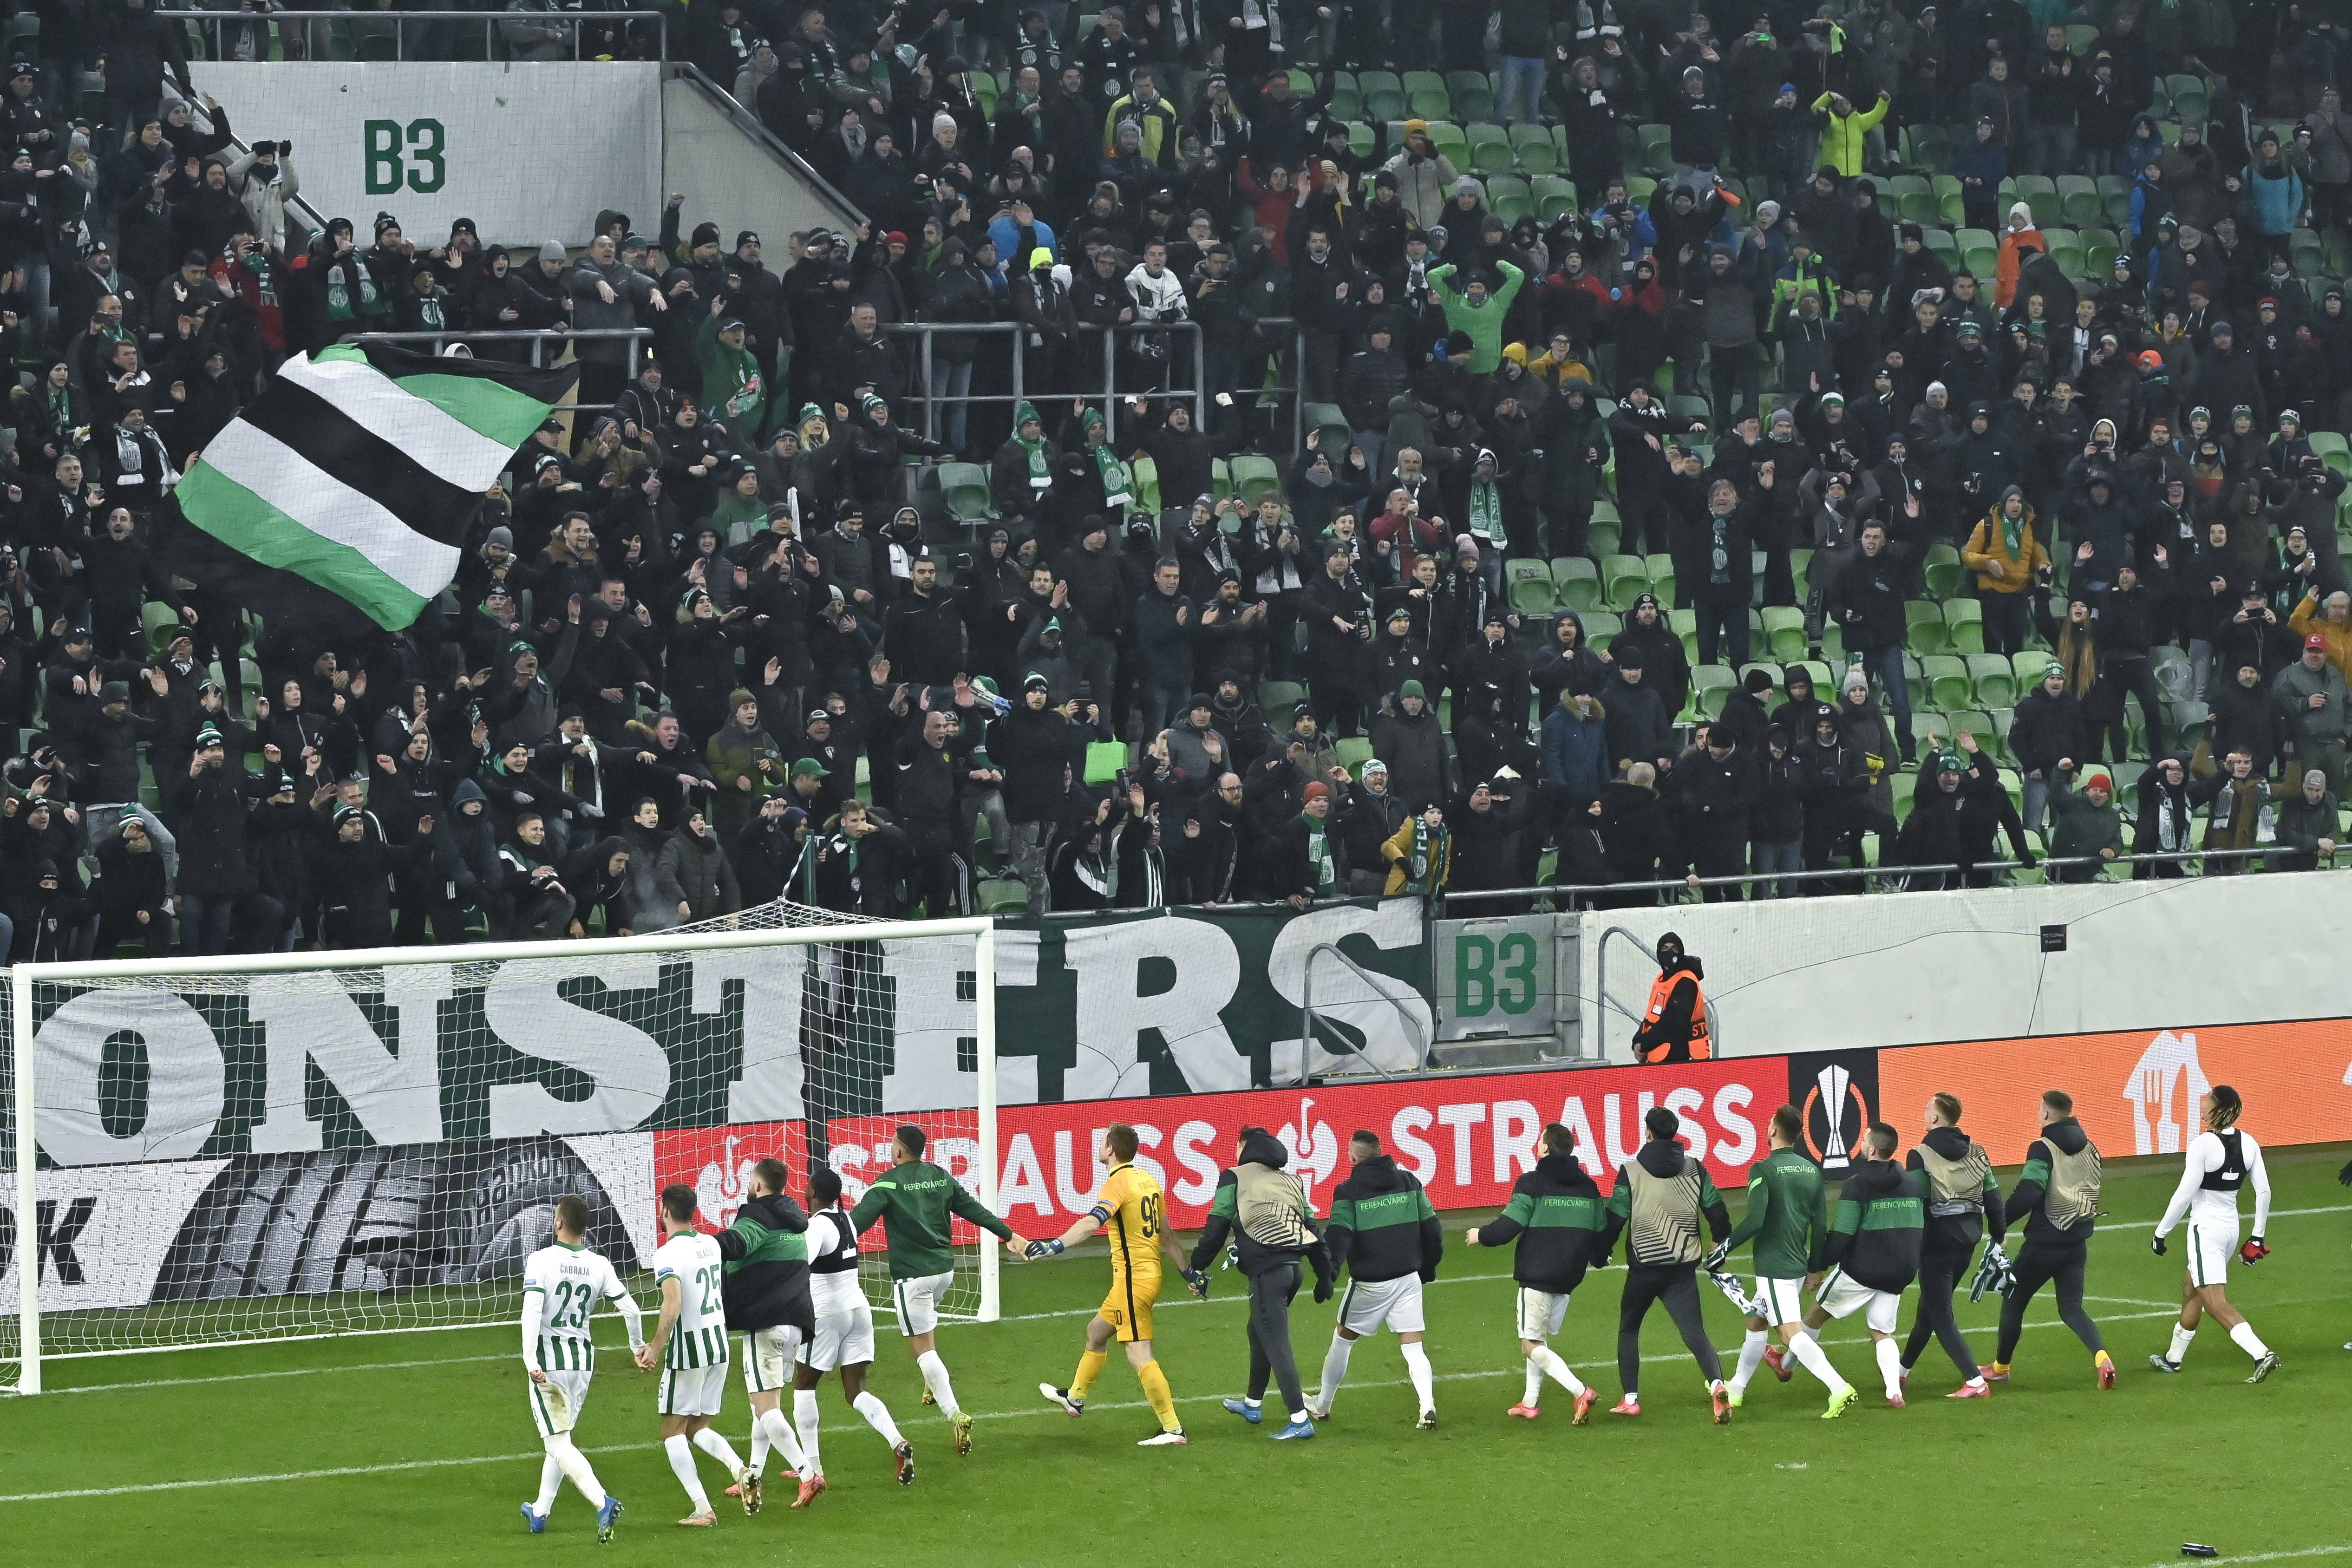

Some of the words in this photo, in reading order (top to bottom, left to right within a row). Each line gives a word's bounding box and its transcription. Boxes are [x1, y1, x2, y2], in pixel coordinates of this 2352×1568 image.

[365, 118, 445, 195] B3
[1455, 933, 1537, 1018] B3
[1391, 1083, 1757, 1187] STRAUSS
[903, 1179, 947, 1191] FERENCVÁROS
[1360, 1195, 1409, 1211] FERENCVÁROS
[1545, 1199, 1590, 1208] FERENCVÁROS
[1872, 1200, 1917, 1211] FERENCVÁROS
[1141, 1193, 1160, 1238] 90
[560, 1263, 590, 1276] ČABRAJA
[696, 1263, 721, 1315] 25
[550, 1281, 592, 1329] 23
